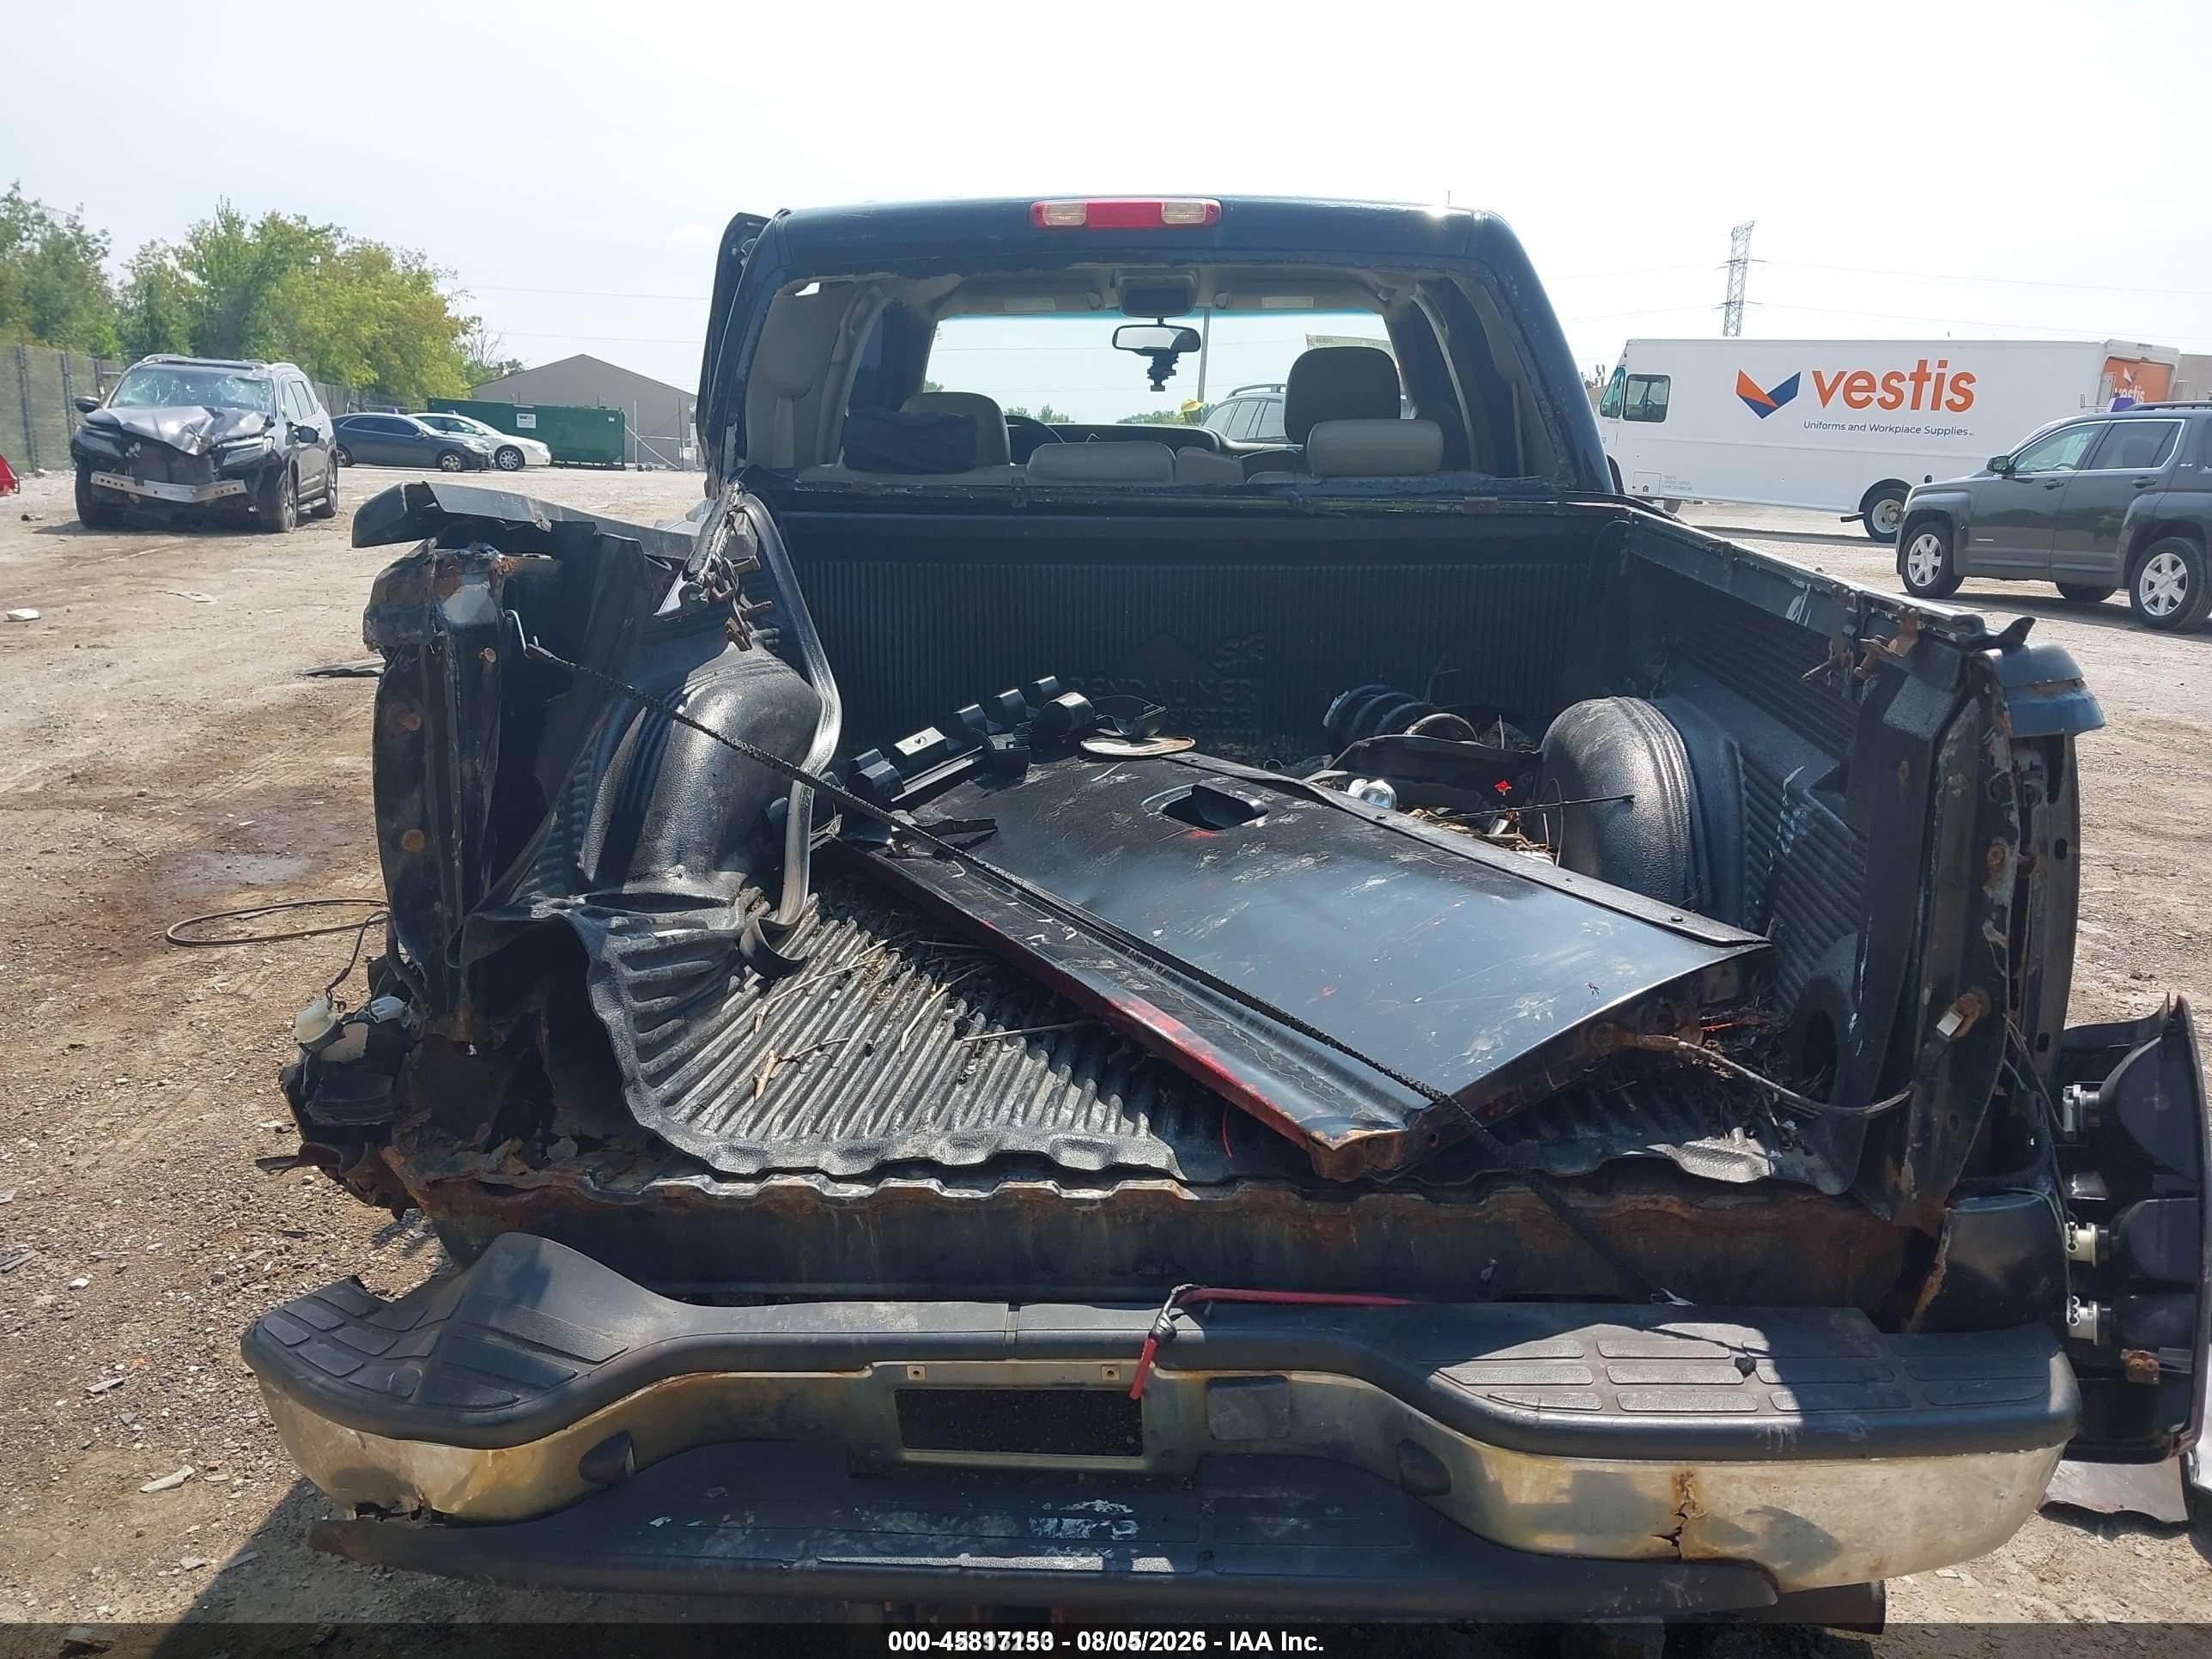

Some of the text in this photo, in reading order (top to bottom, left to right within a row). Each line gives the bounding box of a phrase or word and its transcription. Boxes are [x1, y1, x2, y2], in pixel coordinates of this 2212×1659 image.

[1811, 359, 1977, 413] vestis
[1803, 421, 1846, 431] Uniforms
[1848, 423, 1867, 432] and
[1869, 423, 1922, 435] Workplace
